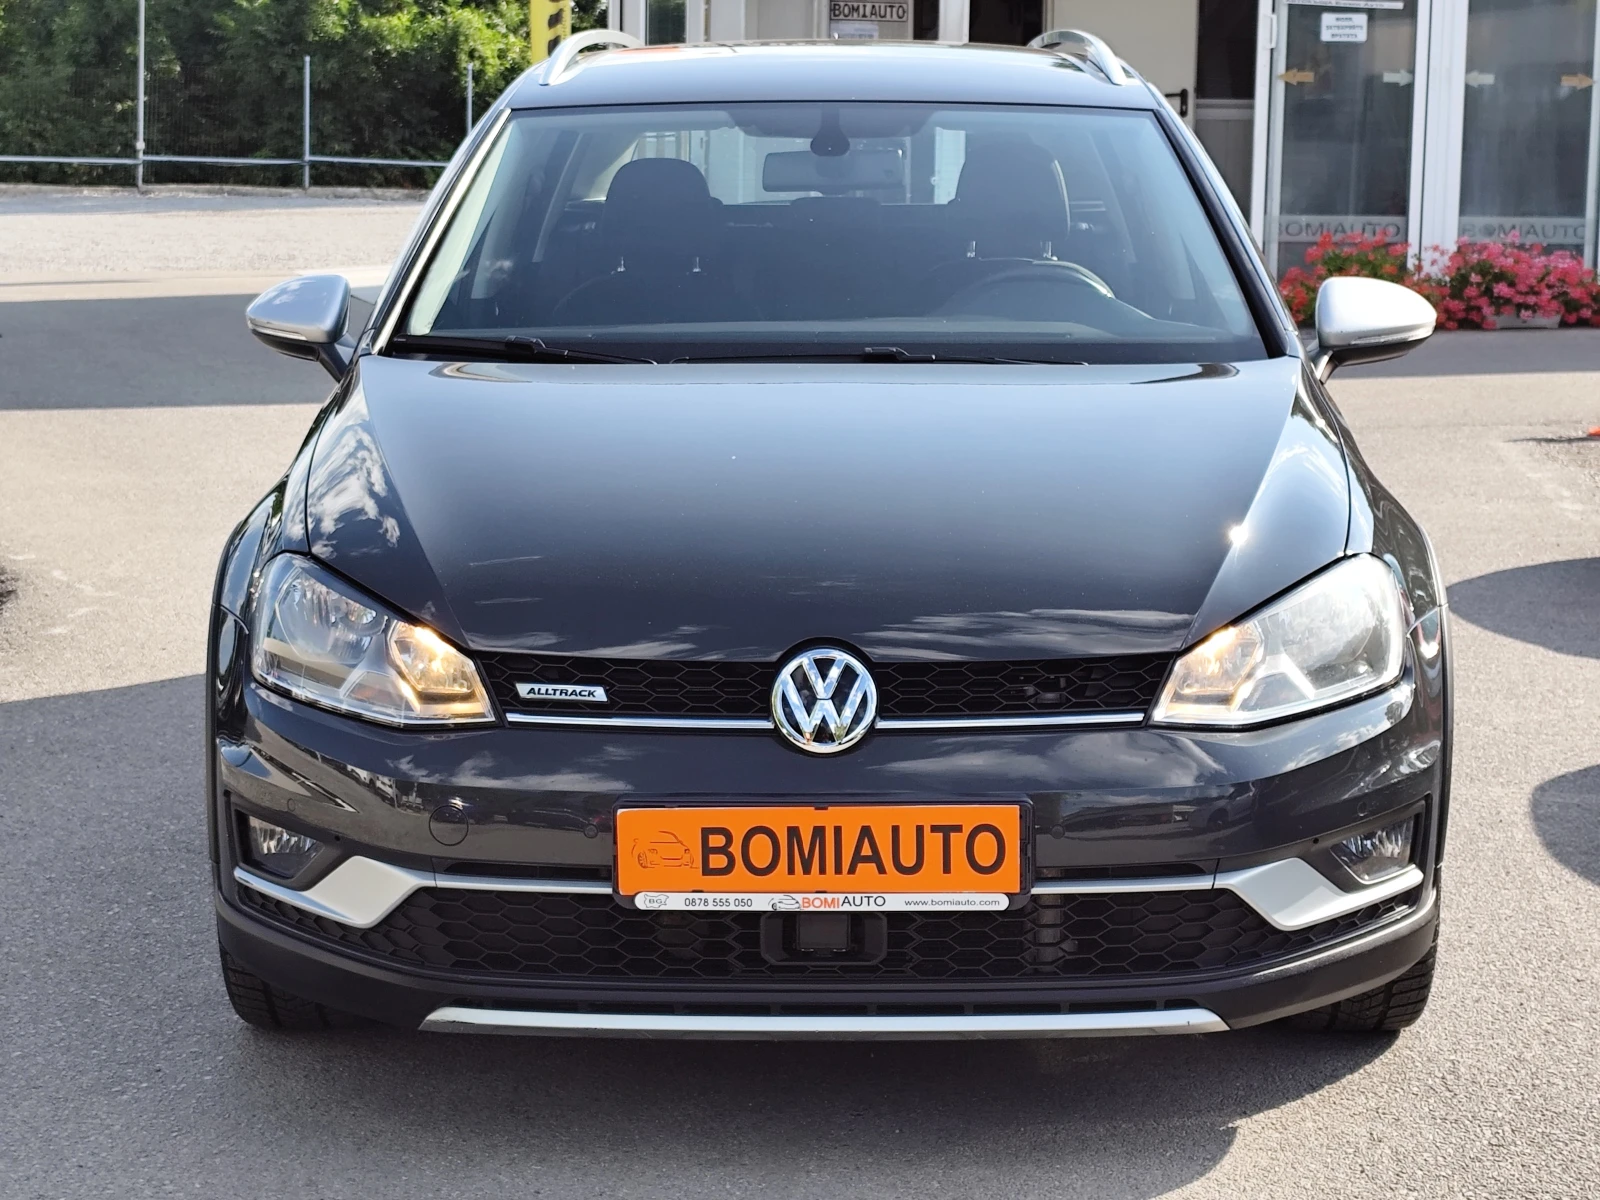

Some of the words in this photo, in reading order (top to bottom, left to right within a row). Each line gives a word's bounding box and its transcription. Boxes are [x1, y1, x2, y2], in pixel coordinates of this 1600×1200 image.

[833, 3, 906, 19] BOMIAUTO
[526, 687, 597, 698] ALLTRACK
[700, 824, 1007, 876] BOMIAUTO
[684, 897, 709, 907] 0878
[712, 898, 731, 907] 555
[733, 898, 753, 908] 050
[904, 898, 1000, 907] www.bomiauto.com
